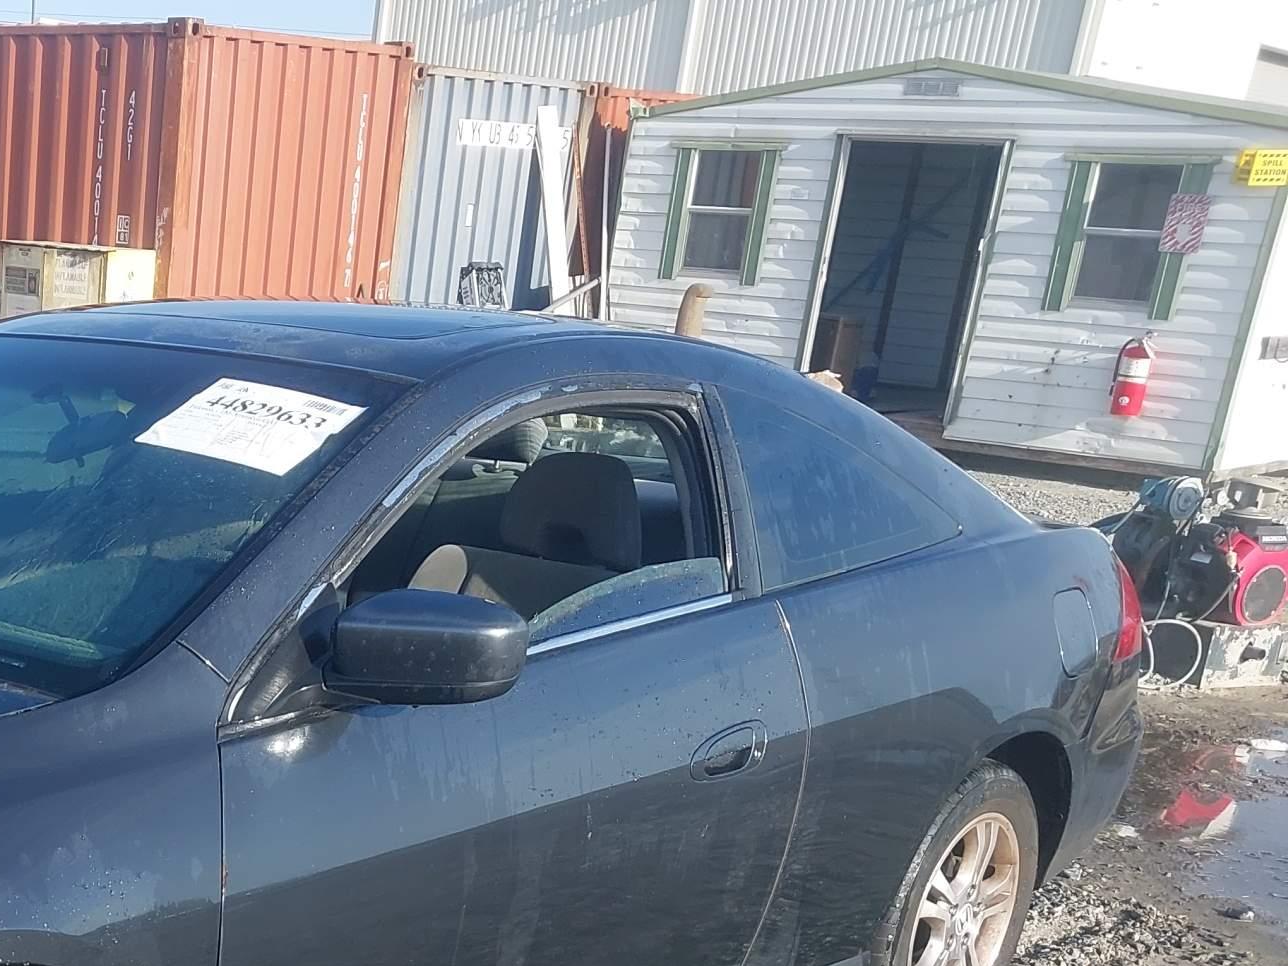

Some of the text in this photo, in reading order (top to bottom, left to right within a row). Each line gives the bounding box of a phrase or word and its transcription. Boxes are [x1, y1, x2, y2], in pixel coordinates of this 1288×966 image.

[97, 89, 106, 160] TCLU
[126, 90, 136, 161] 42G1
[1254, 168, 1287, 176] STATION
[1261, 159, 1283, 167] SPILL
[207, 395, 327, 429] 44829633
